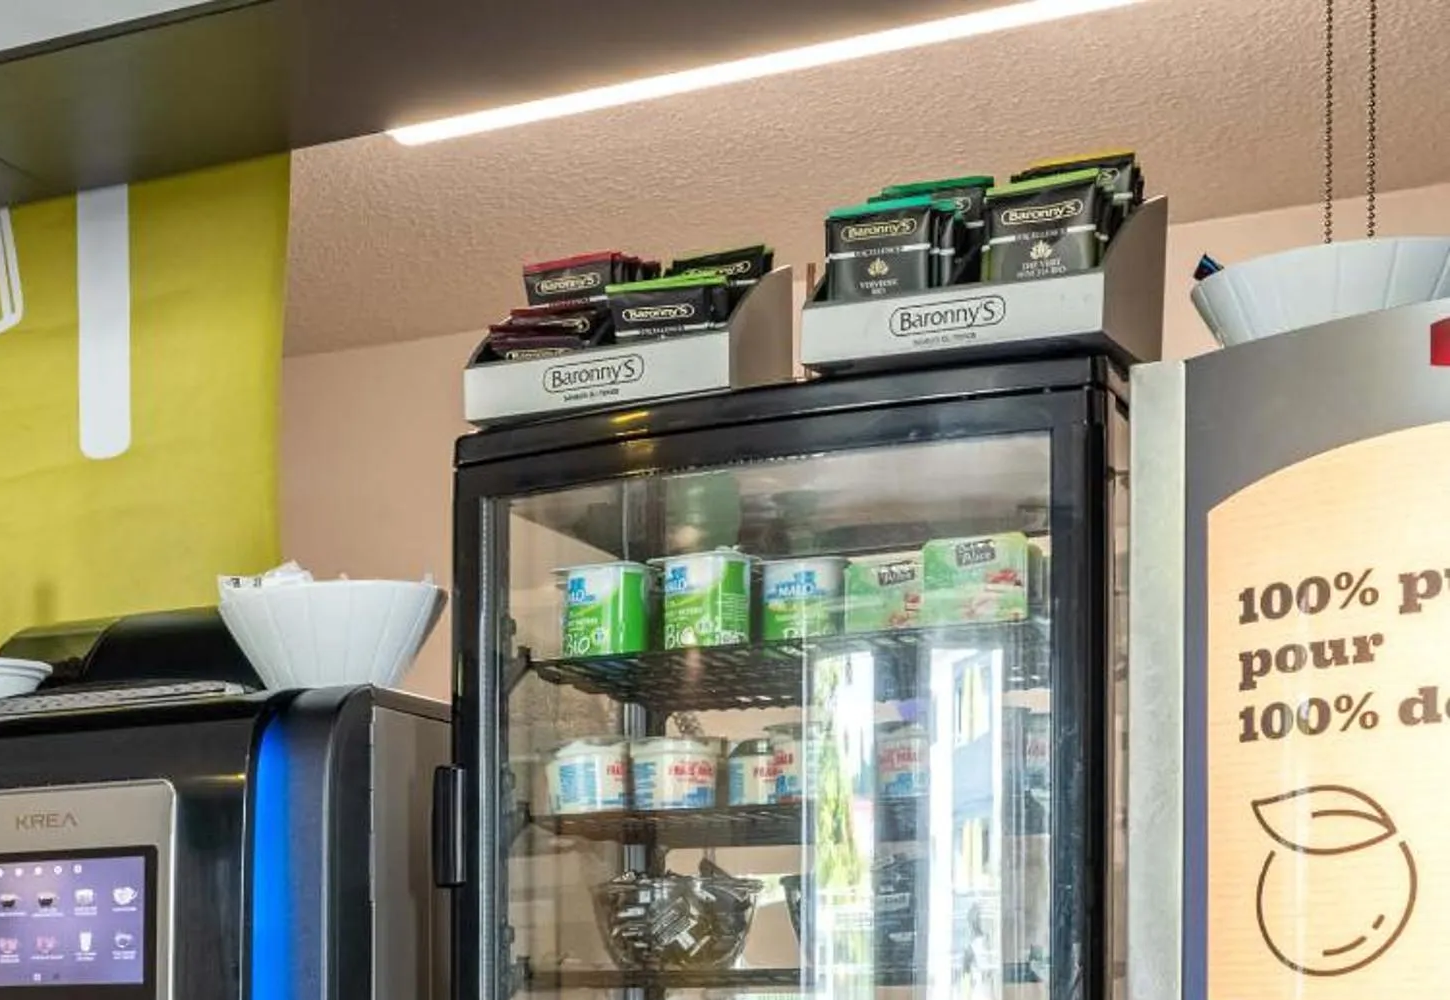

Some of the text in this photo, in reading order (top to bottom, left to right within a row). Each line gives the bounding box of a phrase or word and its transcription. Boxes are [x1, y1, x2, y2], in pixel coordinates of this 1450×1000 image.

[900, 300, 995, 331] Baronny'S
[552, 359, 635, 389] Baronny'S
[1238, 568, 1379, 625] 100%
[1238, 632, 1384, 691] pour
[1238, 686, 1450, 743] 100% d
[15, 811, 79, 831] KREA
